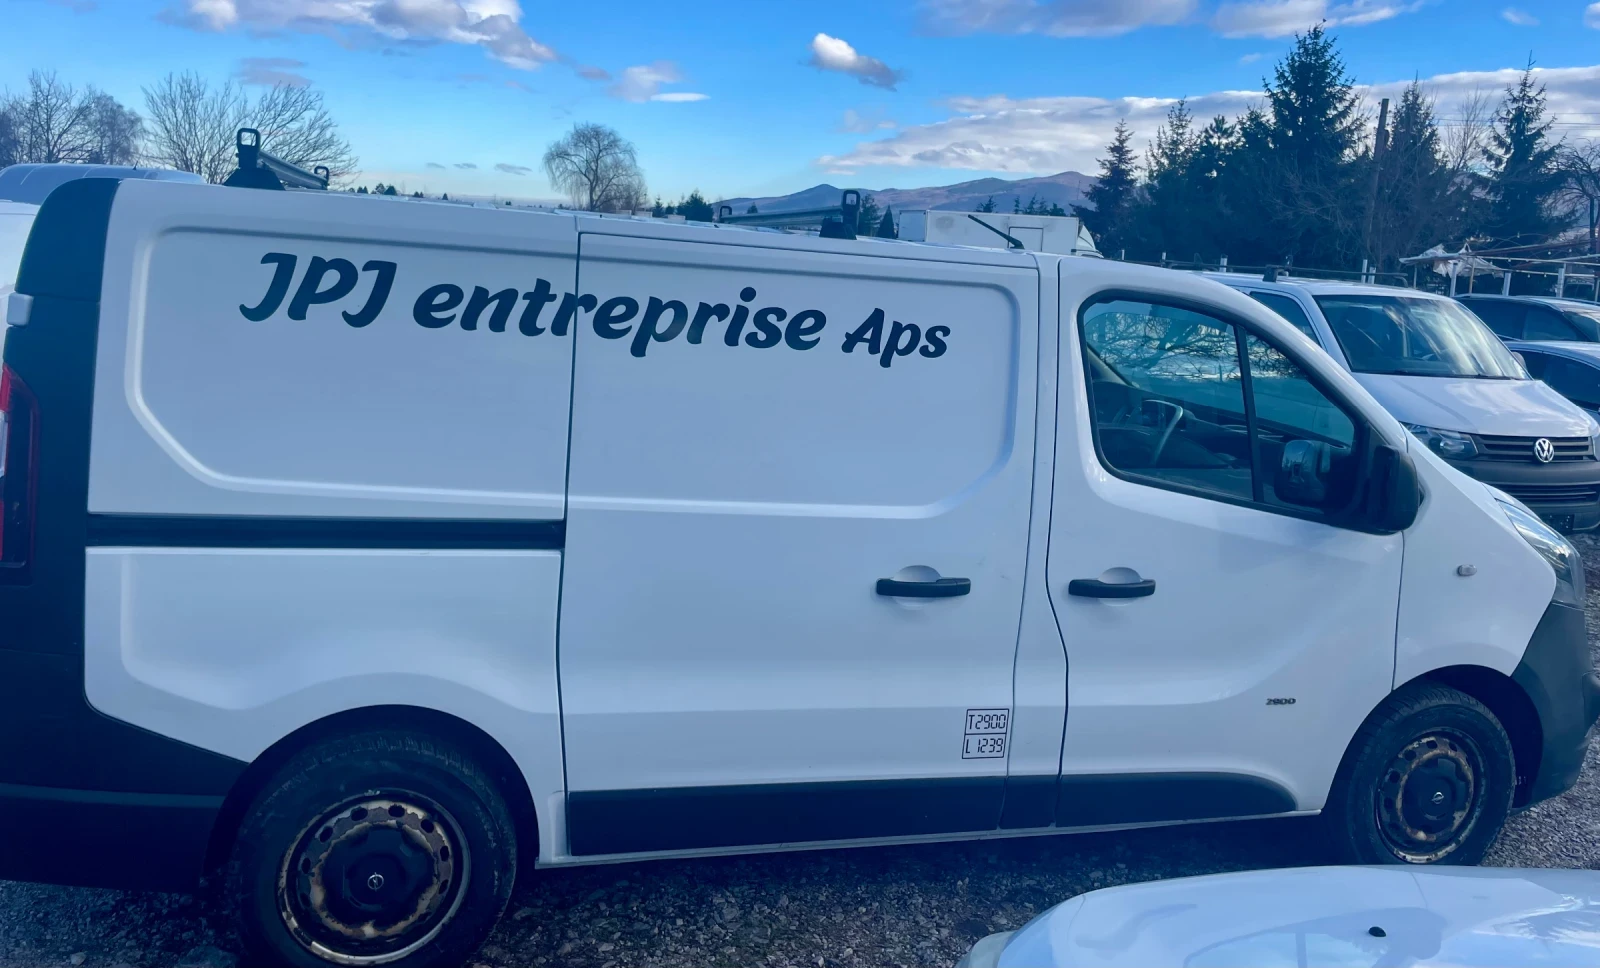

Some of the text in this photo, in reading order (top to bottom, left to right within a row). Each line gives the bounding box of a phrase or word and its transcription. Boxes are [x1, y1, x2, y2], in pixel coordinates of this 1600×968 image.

[239, 252, 951, 368] JPJ entreprise Aps
[968, 714, 1007, 730] T2900
